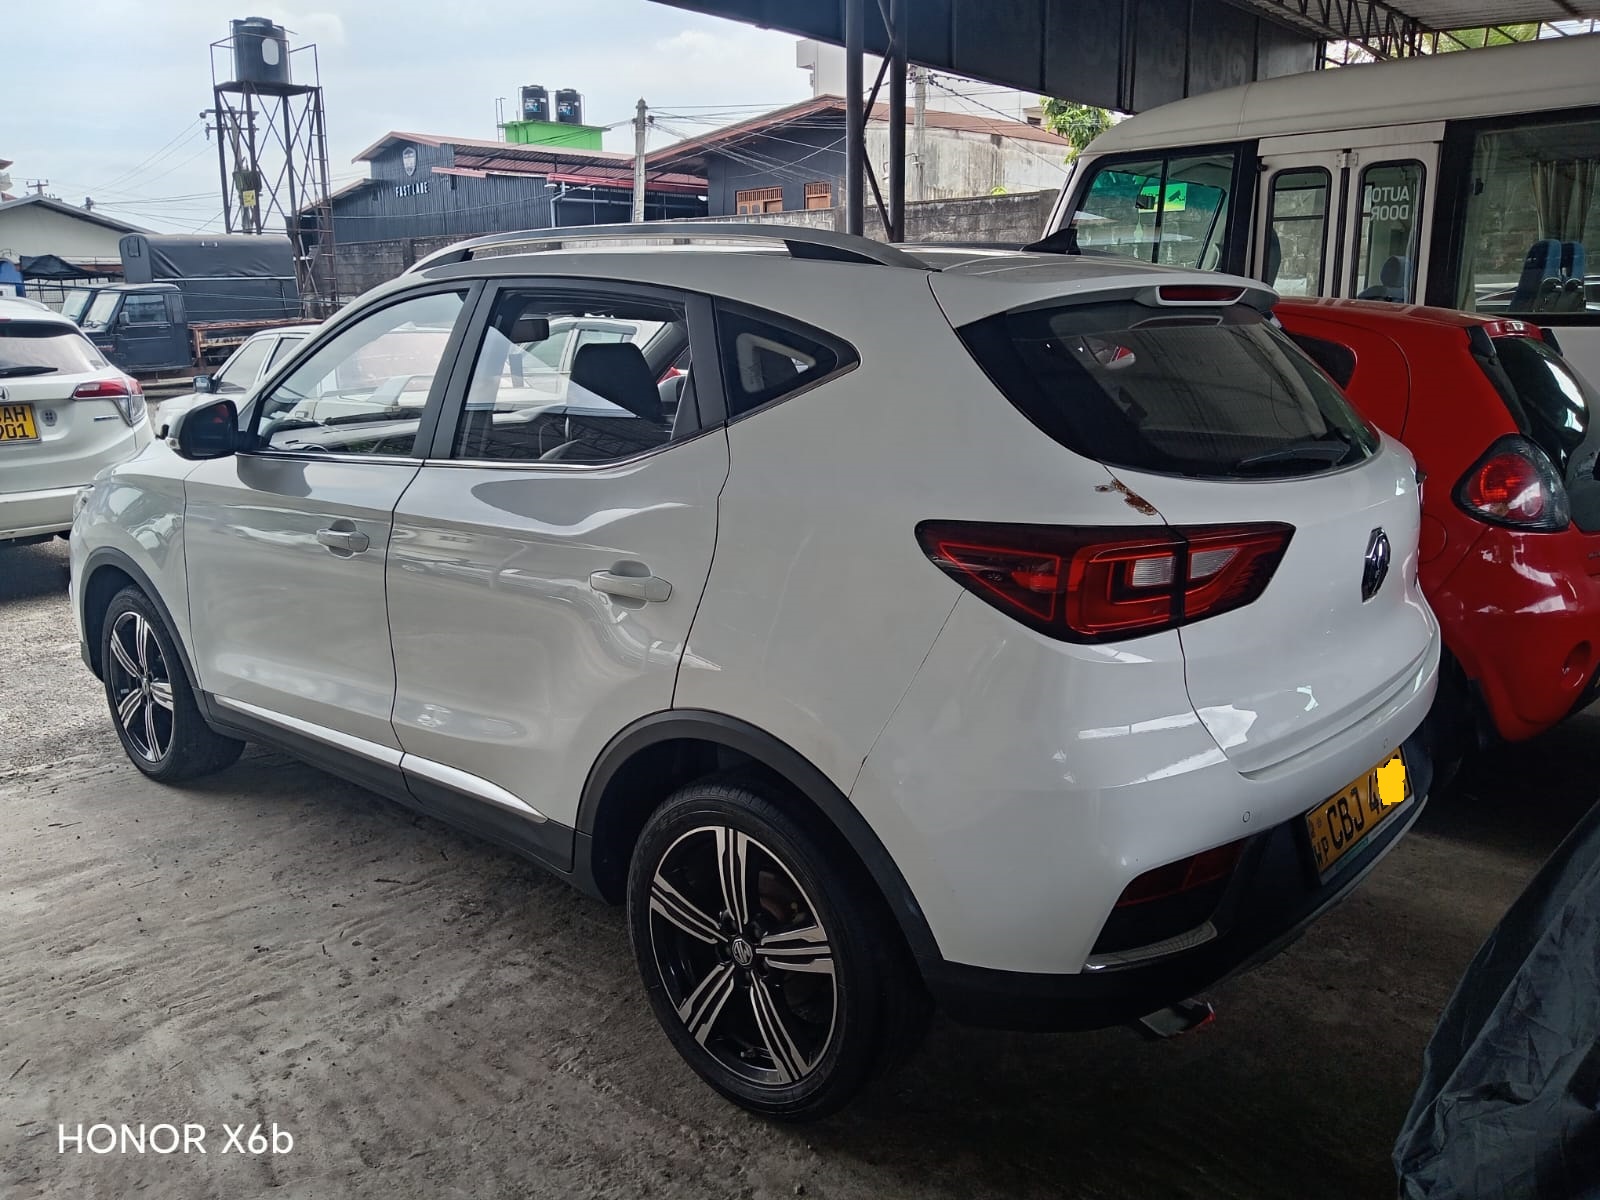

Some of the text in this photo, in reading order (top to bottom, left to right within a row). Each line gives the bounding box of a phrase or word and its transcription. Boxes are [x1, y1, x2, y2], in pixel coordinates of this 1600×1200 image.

[395, 184, 410, 198] FAST
[0, 406, 27, 423] AH
[1326, 786, 1365, 850] CBJ
